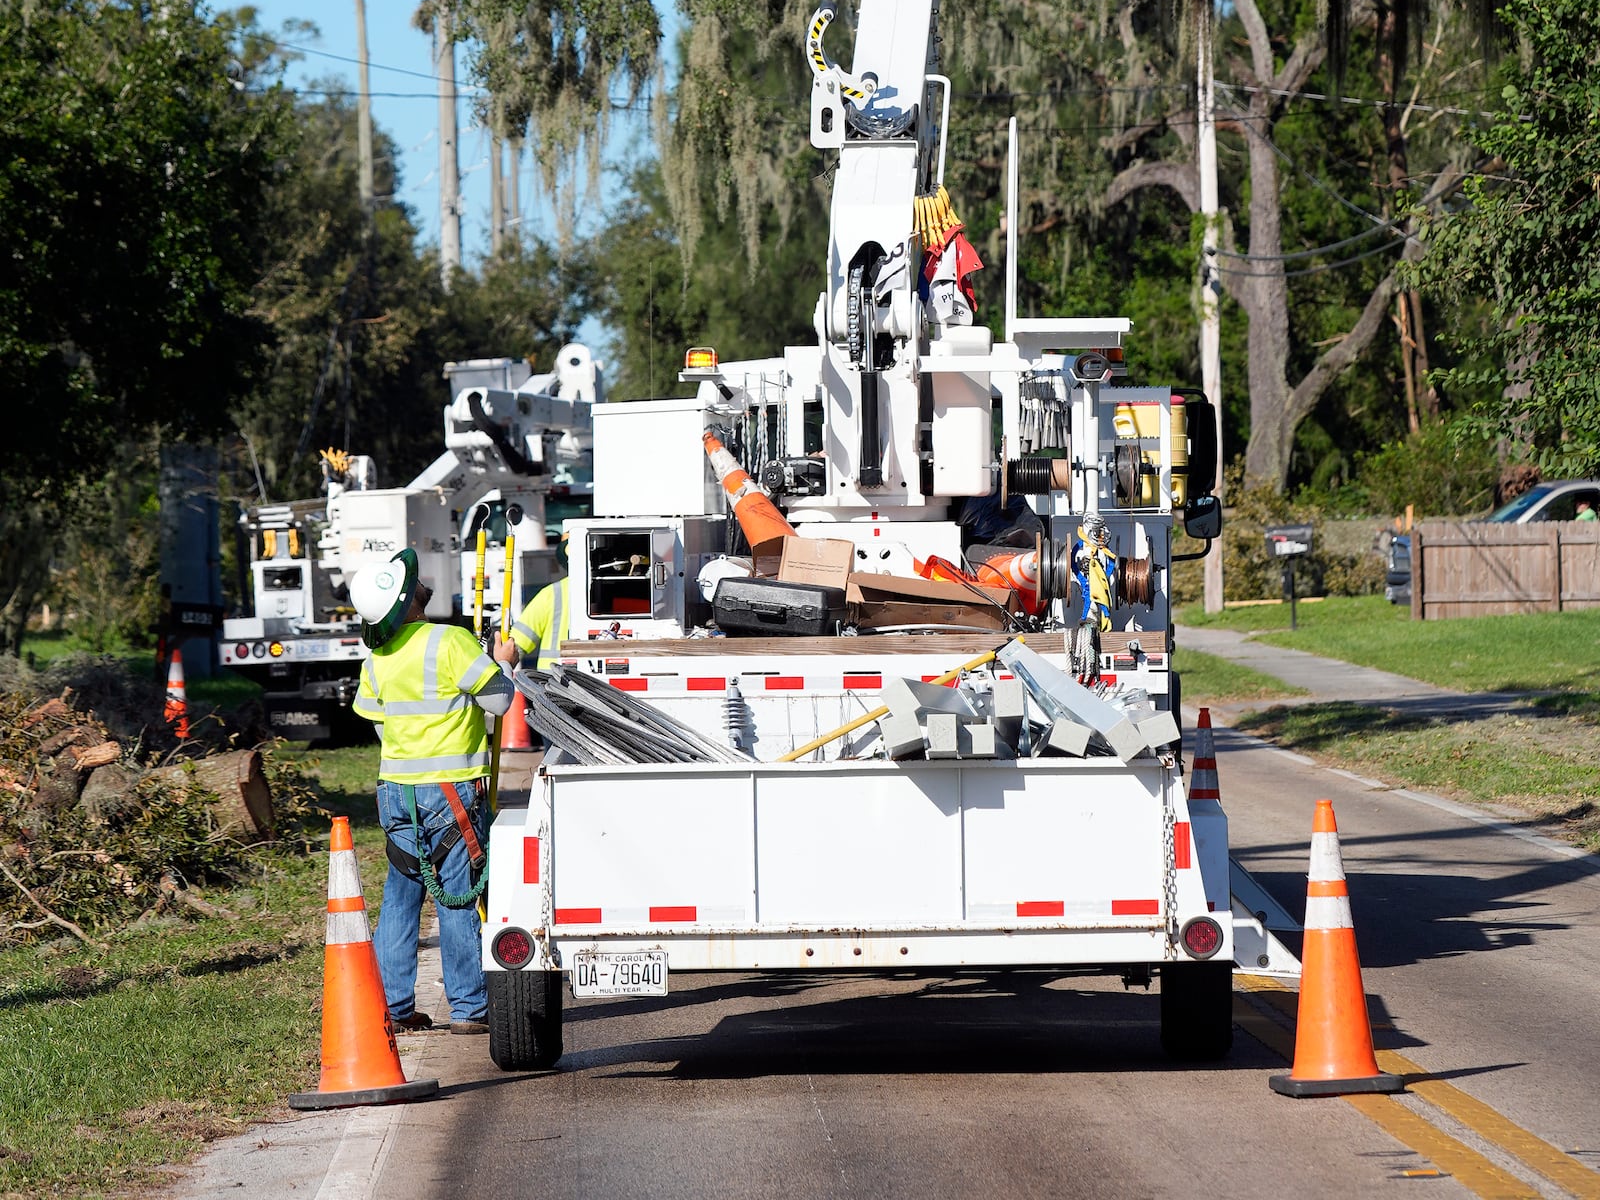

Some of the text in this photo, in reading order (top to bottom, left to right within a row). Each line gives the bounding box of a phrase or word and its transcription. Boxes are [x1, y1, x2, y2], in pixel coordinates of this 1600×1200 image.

[362, 538, 396, 553] Altec
[286, 711, 320, 726] Altec
[615, 954, 662, 963] CAROLINA
[578, 962, 662, 987] DA-79640
